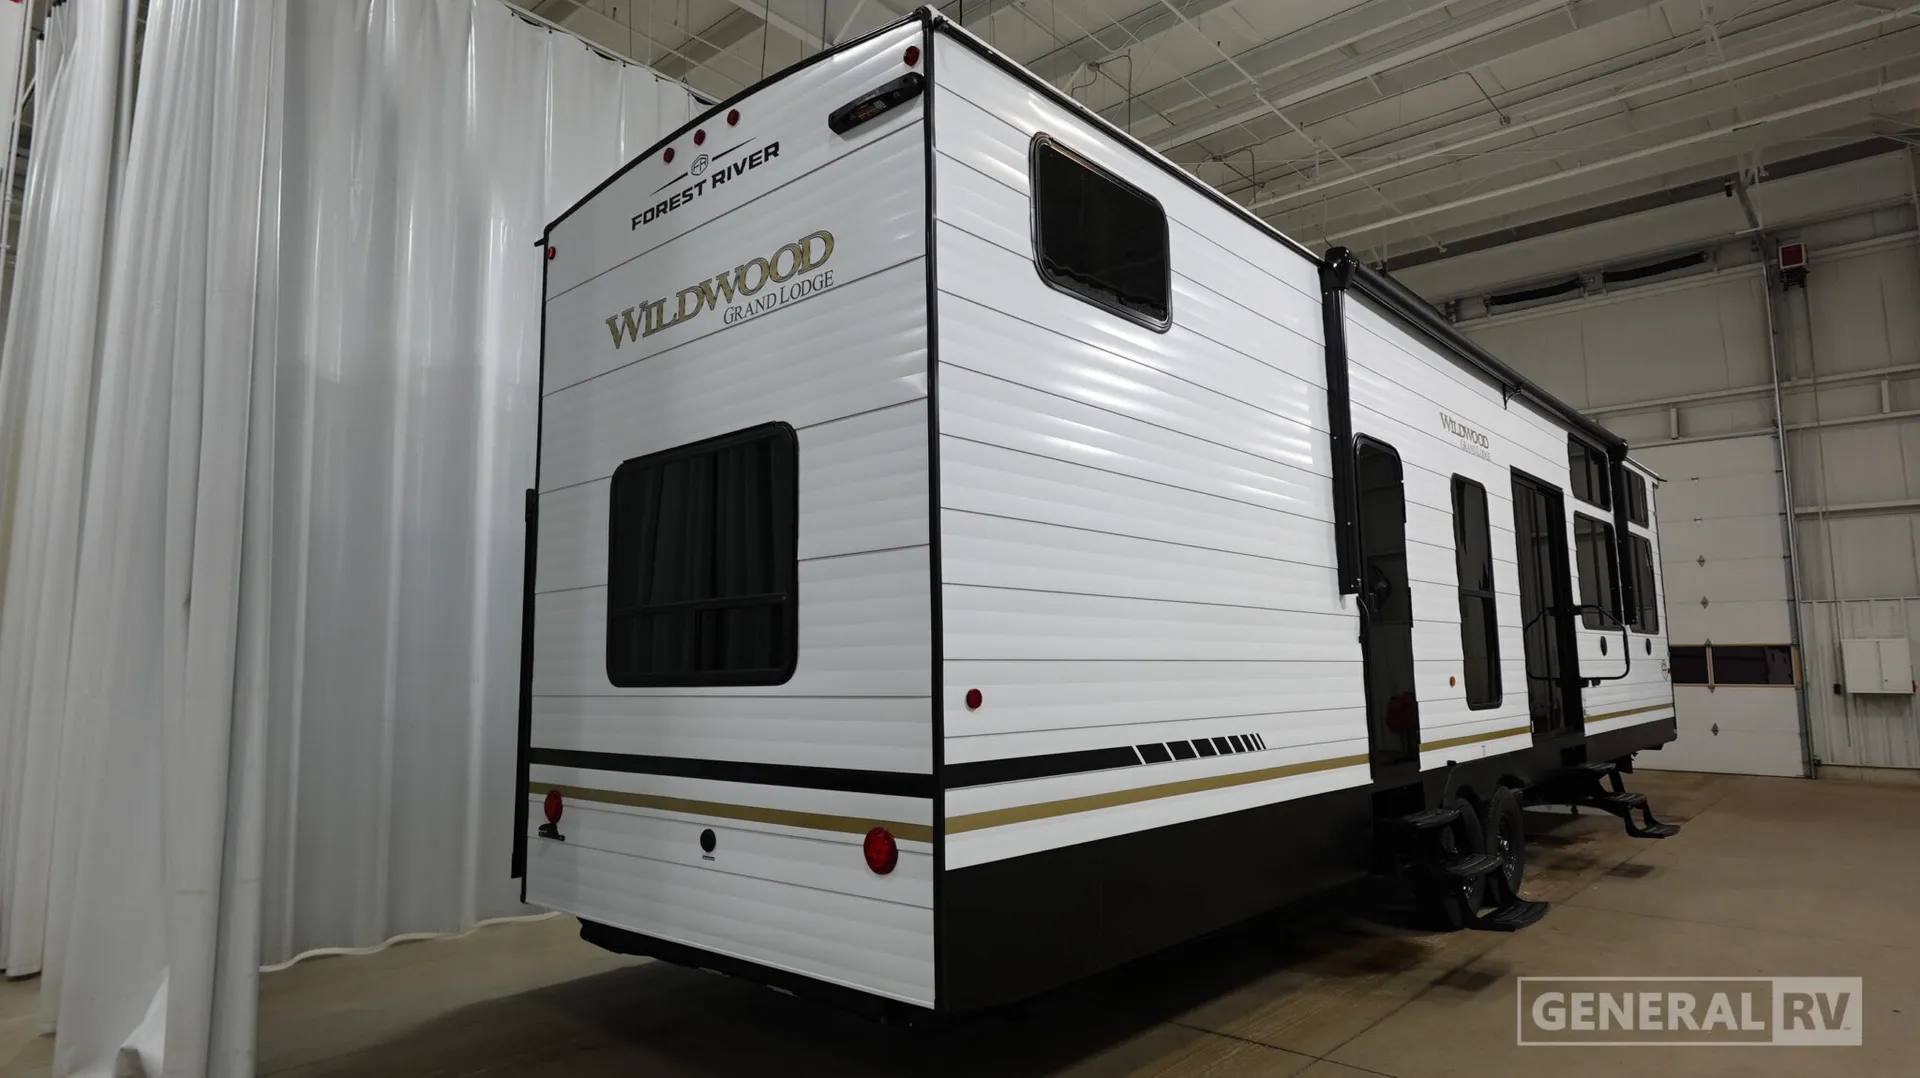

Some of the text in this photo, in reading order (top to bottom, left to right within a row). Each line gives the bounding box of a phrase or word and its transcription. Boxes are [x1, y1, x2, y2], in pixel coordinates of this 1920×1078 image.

[631, 141, 780, 231] FOREST RIVER
[605, 230, 834, 350] WILDWOOD
[723, 269, 834, 325] GRAND LODGE
[1439, 411, 1489, 449] WILDWOOD
